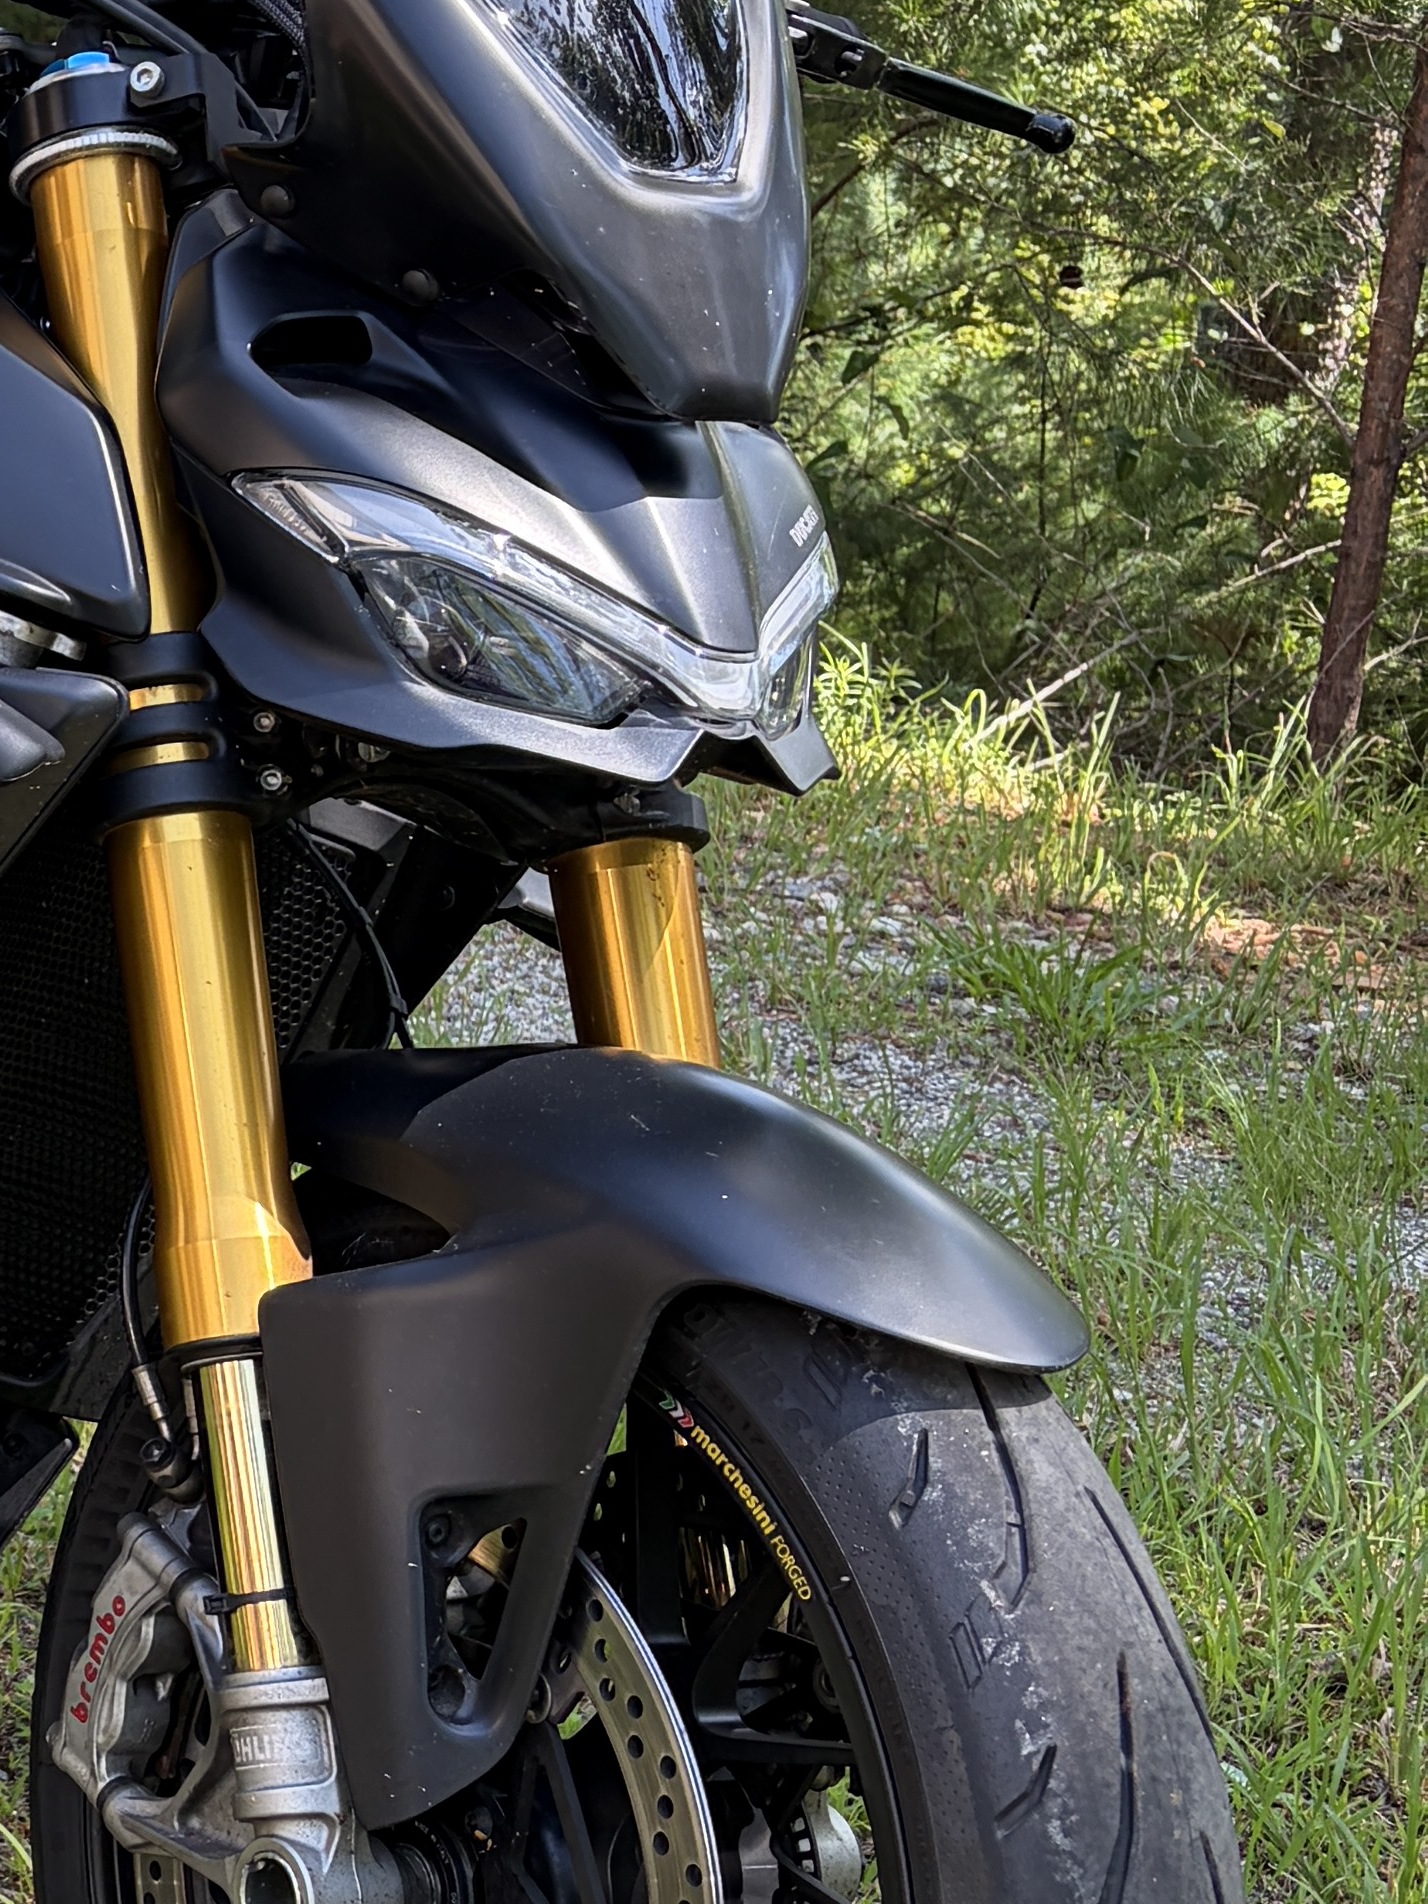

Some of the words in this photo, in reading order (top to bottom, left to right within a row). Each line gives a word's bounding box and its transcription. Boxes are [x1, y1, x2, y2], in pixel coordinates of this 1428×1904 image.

[690, 1425, 778, 1535] marchesini
[770, 1535, 811, 1600] FORGED
[70, 1595, 126, 1723] brembo
